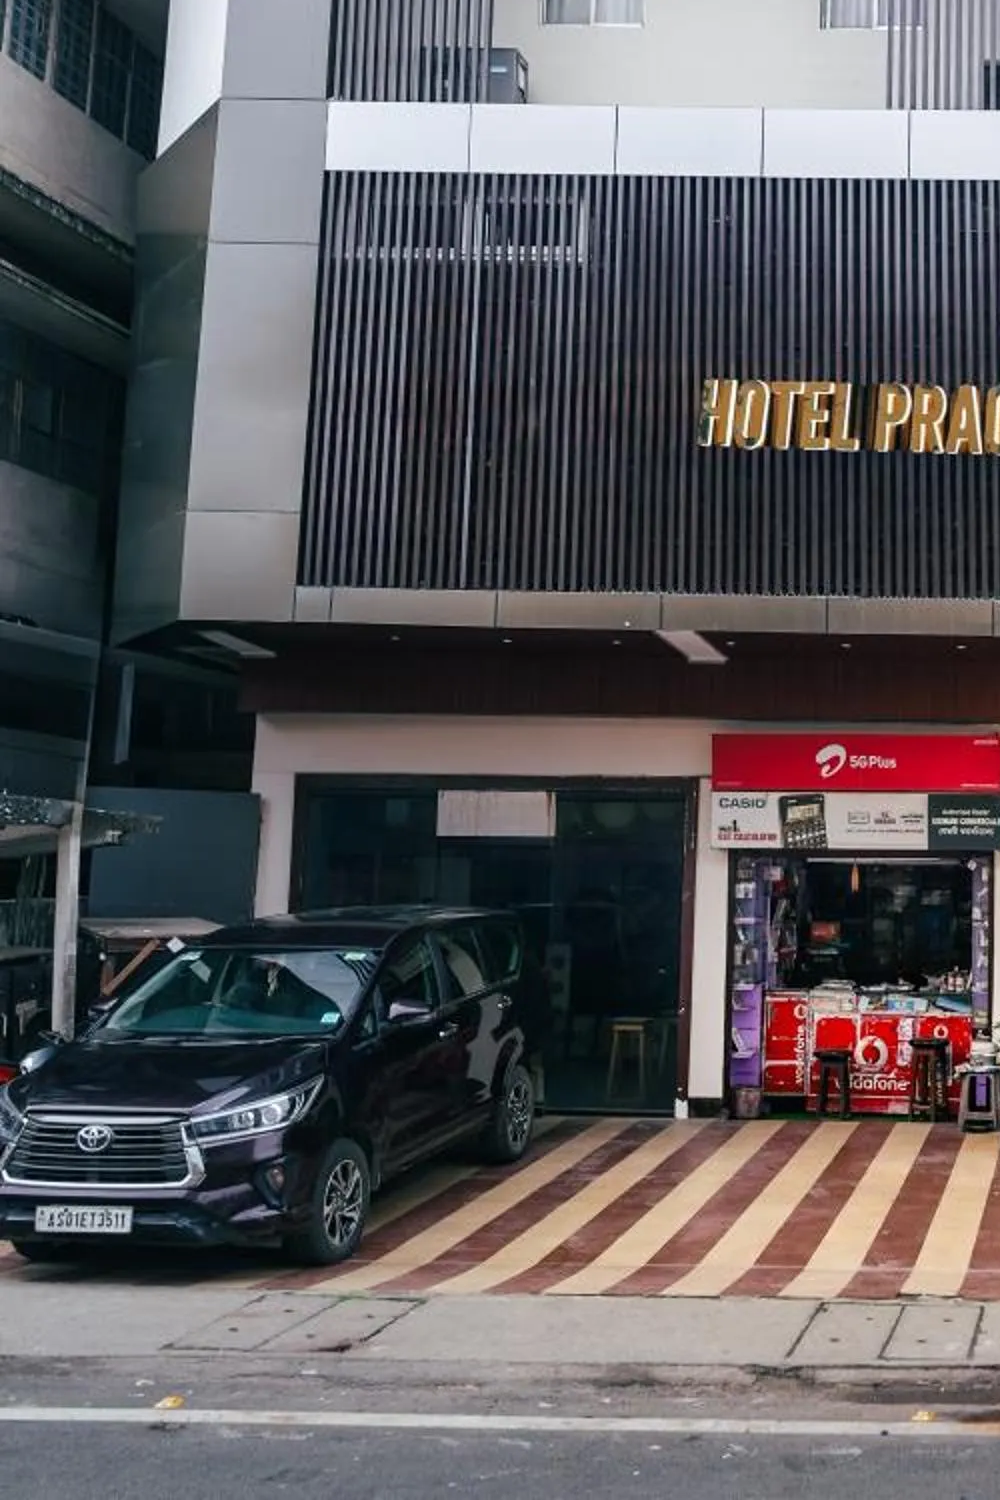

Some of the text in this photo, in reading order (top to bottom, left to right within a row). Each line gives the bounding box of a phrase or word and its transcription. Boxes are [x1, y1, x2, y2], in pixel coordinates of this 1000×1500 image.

[698, 379, 861, 451] HOTEL
[849, 755, 897, 769] 5G Plus
[719, 797, 766, 809] CASIO
[834, 1068, 911, 1091] vdafone
